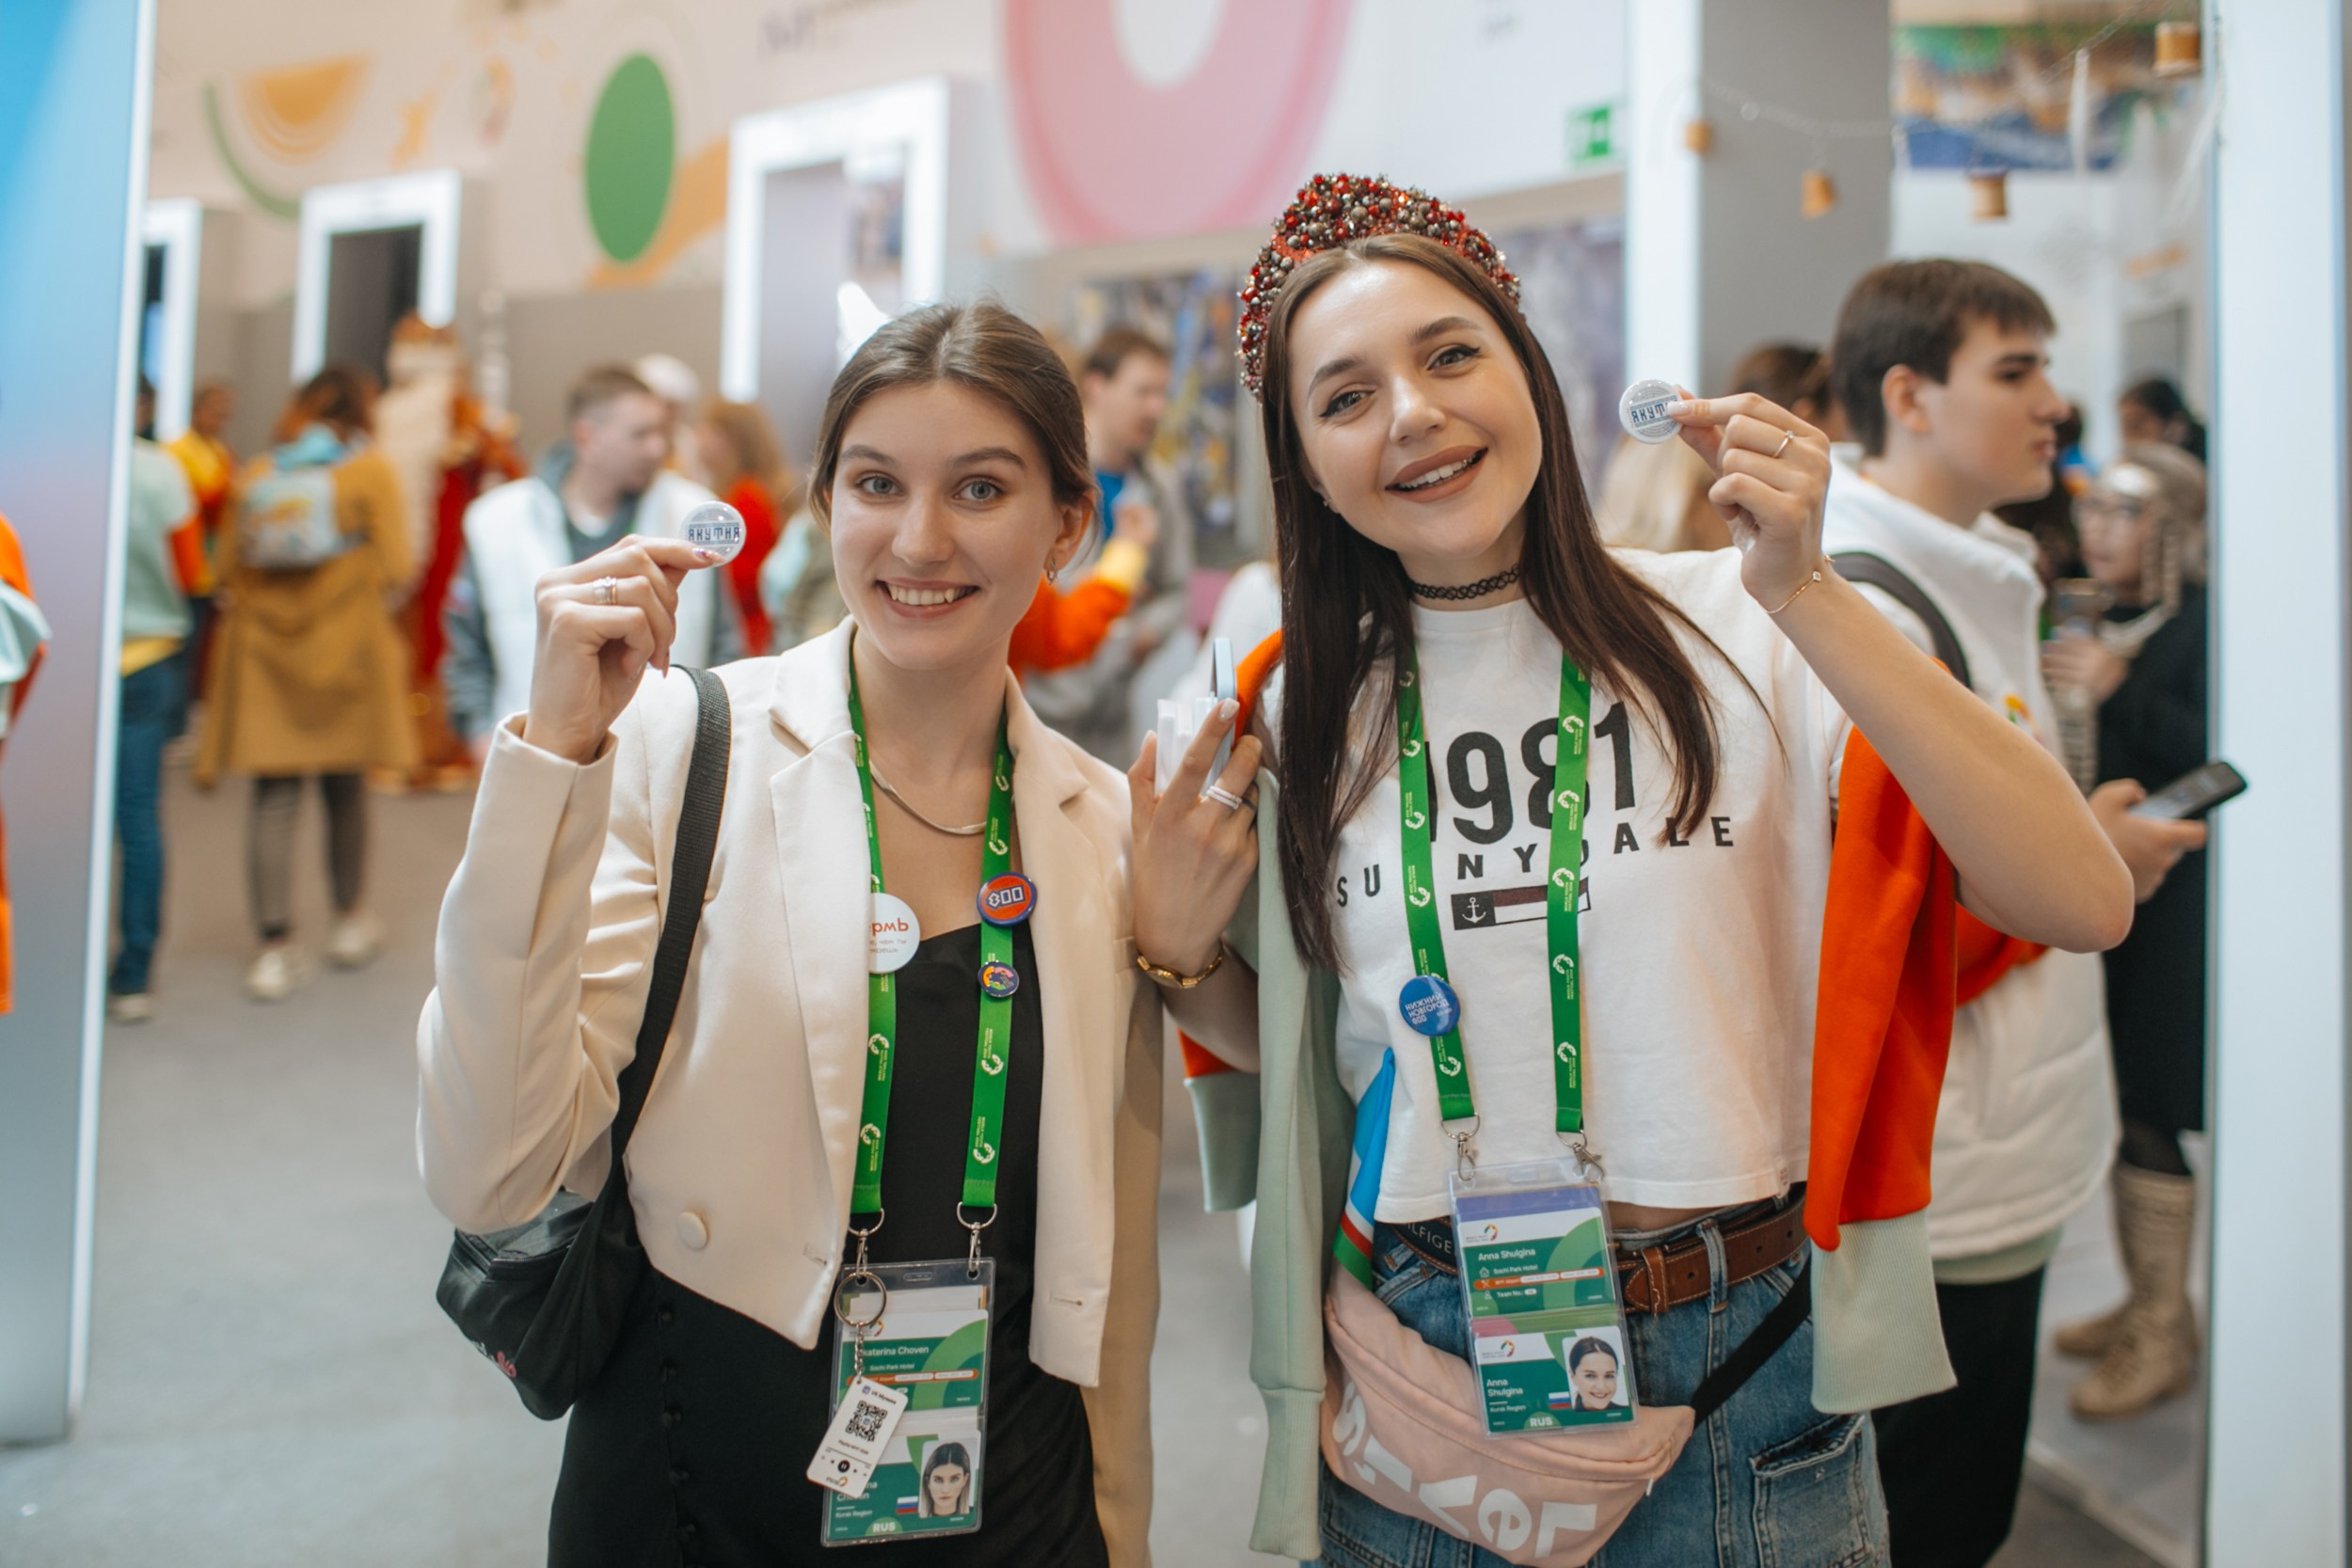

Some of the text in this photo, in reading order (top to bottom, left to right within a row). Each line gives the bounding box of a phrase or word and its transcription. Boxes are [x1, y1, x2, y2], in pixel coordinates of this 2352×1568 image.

[1631, 402, 1667, 423] ЯКУТ
[1337, 816, 1735, 908] SUNYALE
[869, 917, 910, 936] рмь
[1405, 991, 1443, 1011] НИЖНИЙ
[1407, 998, 1450, 1018] НОВГОРОД
[1407, 1223, 1452, 1255] LFIGE
[1478, 1247, 1536, 1261] Anna Shulgina
[1508, 1265, 1522, 1274] Park
[1521, 1263, 1538, 1272] Hotel
[859, 1345, 930, 1356] katerina Choven
[1486, 1378, 1508, 1387] Anna
[1487, 1386, 1523, 1398] Shulgina
[1530, 1417, 1553, 1428] RUS
[873, 1521, 897, 1532] RUS
